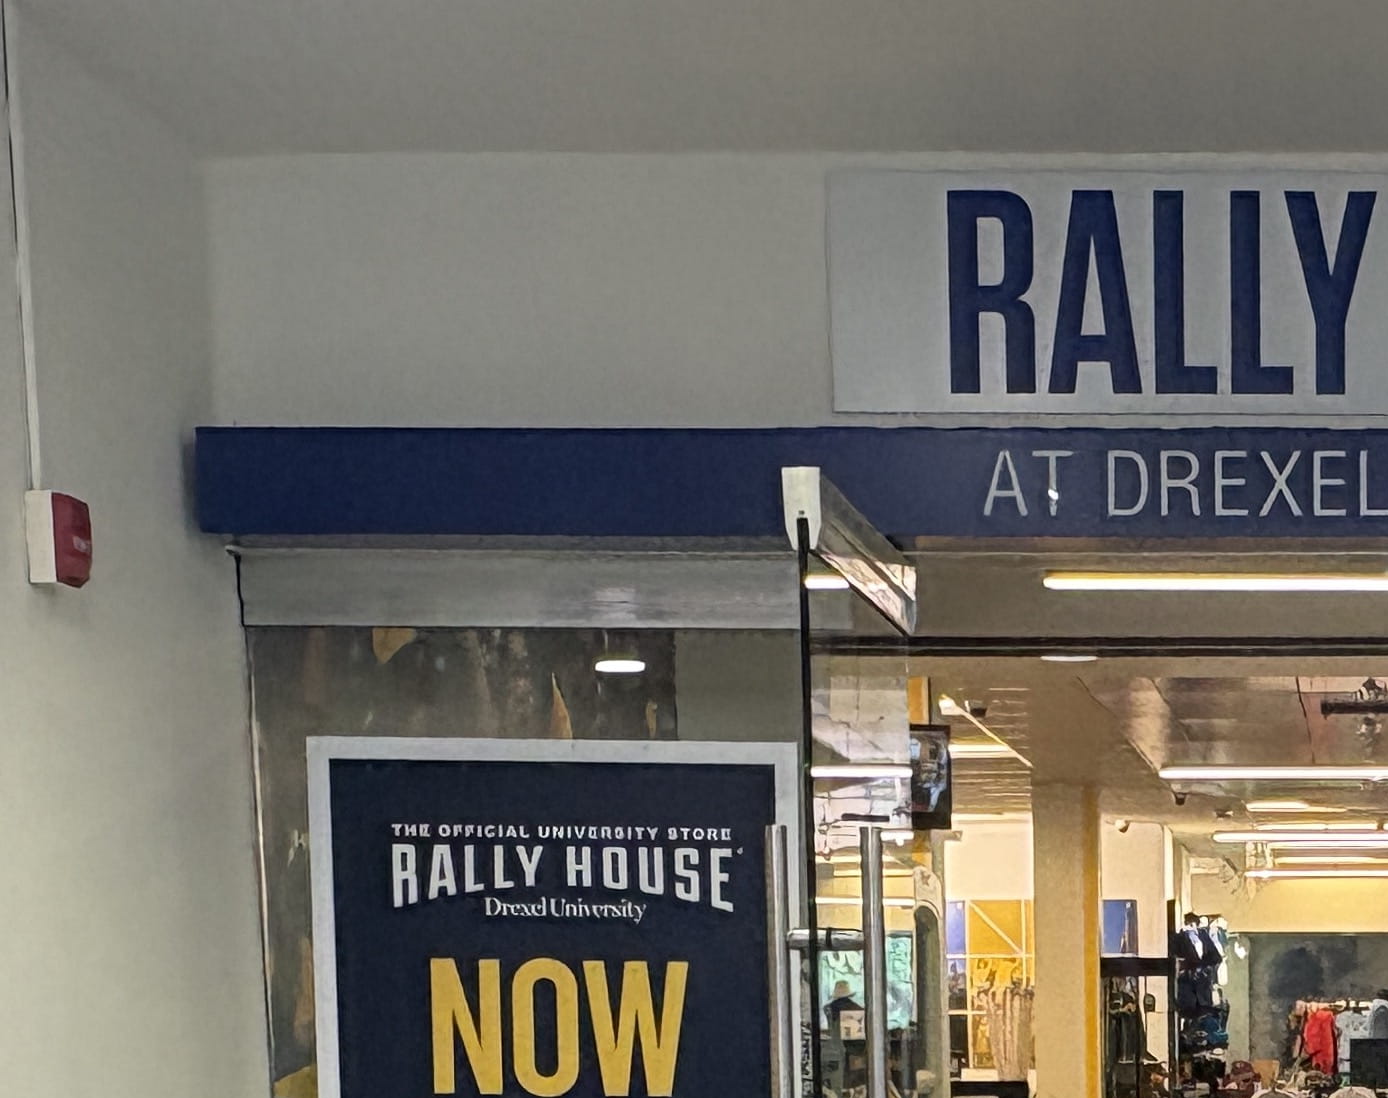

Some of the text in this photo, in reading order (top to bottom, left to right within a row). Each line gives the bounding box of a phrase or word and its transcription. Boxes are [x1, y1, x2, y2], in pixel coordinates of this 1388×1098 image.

[946, 188, 1380, 396] RALLY
[983, 449, 1075, 519] AT
[391, 823, 732, 842] THE OFFICIAL UNIVERSITY STORE
[392, 842, 734, 913] RALLY HOUSE
[484, 895, 647, 924] Drexel University
[430, 957, 689, 1098] NOW
